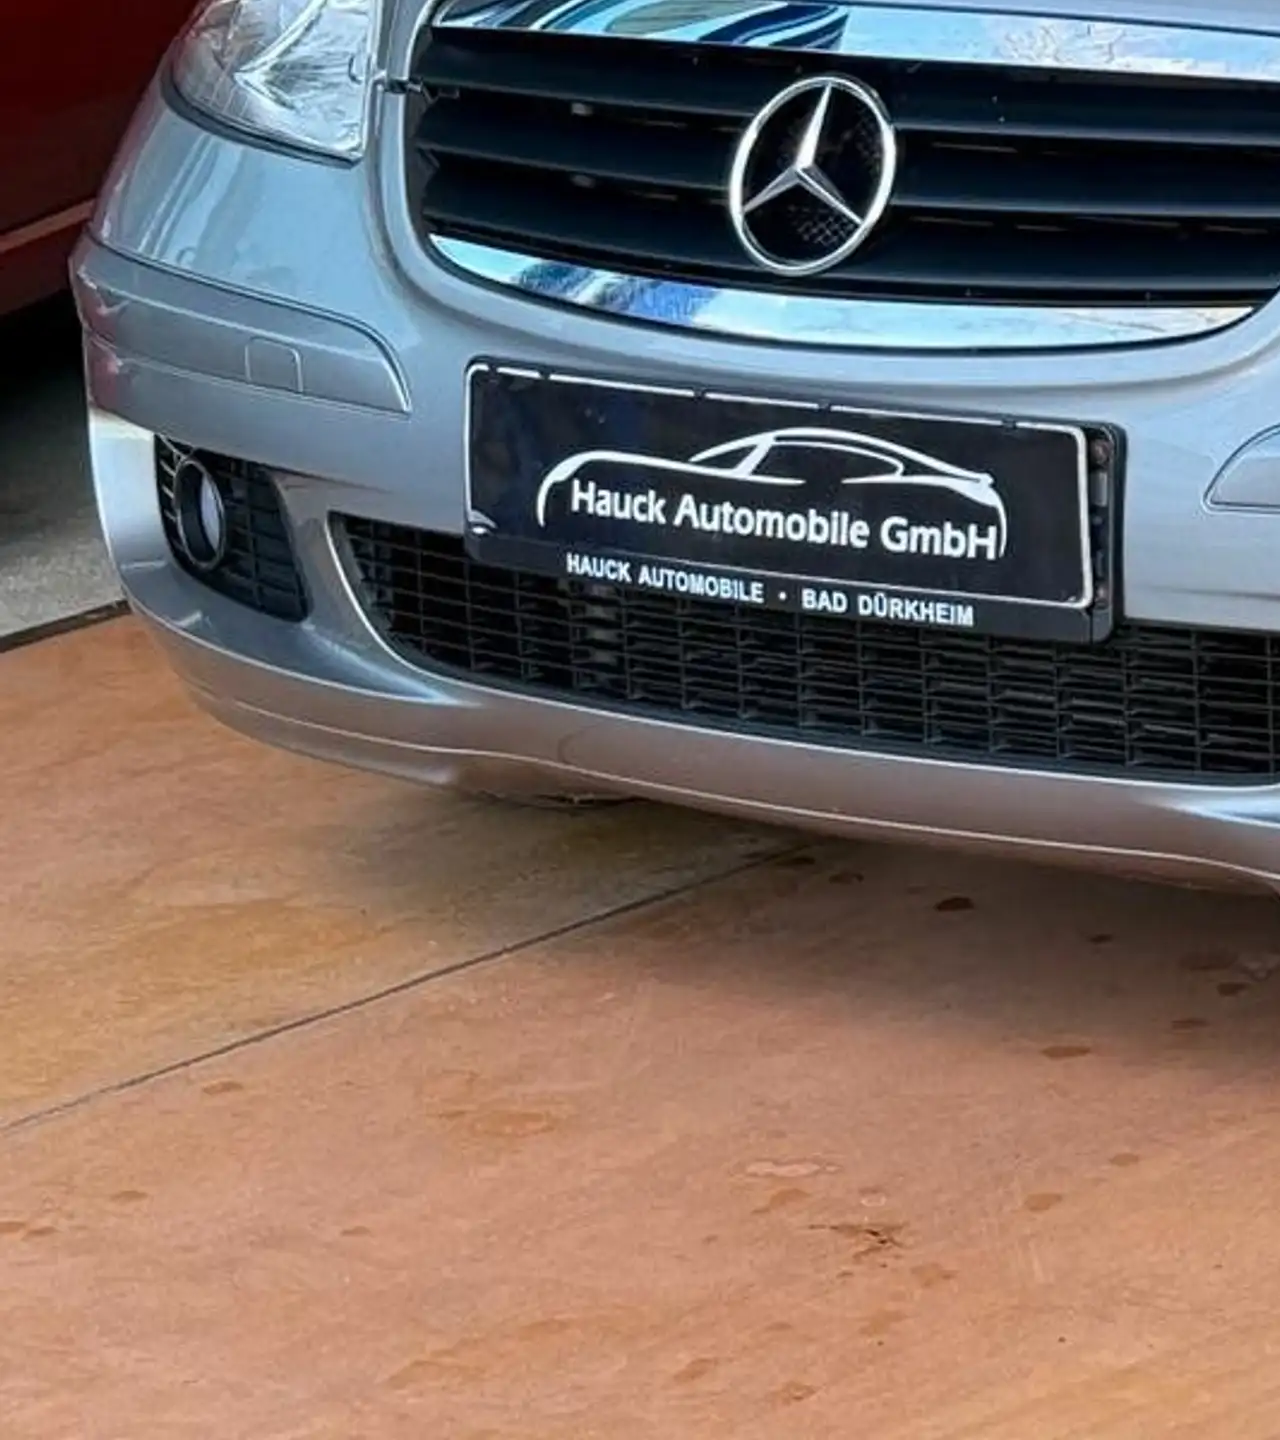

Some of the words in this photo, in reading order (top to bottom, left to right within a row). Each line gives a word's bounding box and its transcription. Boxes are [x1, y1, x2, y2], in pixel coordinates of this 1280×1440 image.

[570, 477, 667, 525] Hauck
[672, 493, 870, 549] Automobile
[880, 515, 997, 560] GmbH
[566, 552, 632, 583] HAUCK
[638, 564, 765, 604] AUTOMOBILE
[801, 587, 848, 614] BAD
[857, 591, 974, 627] DÜRKHEIM
